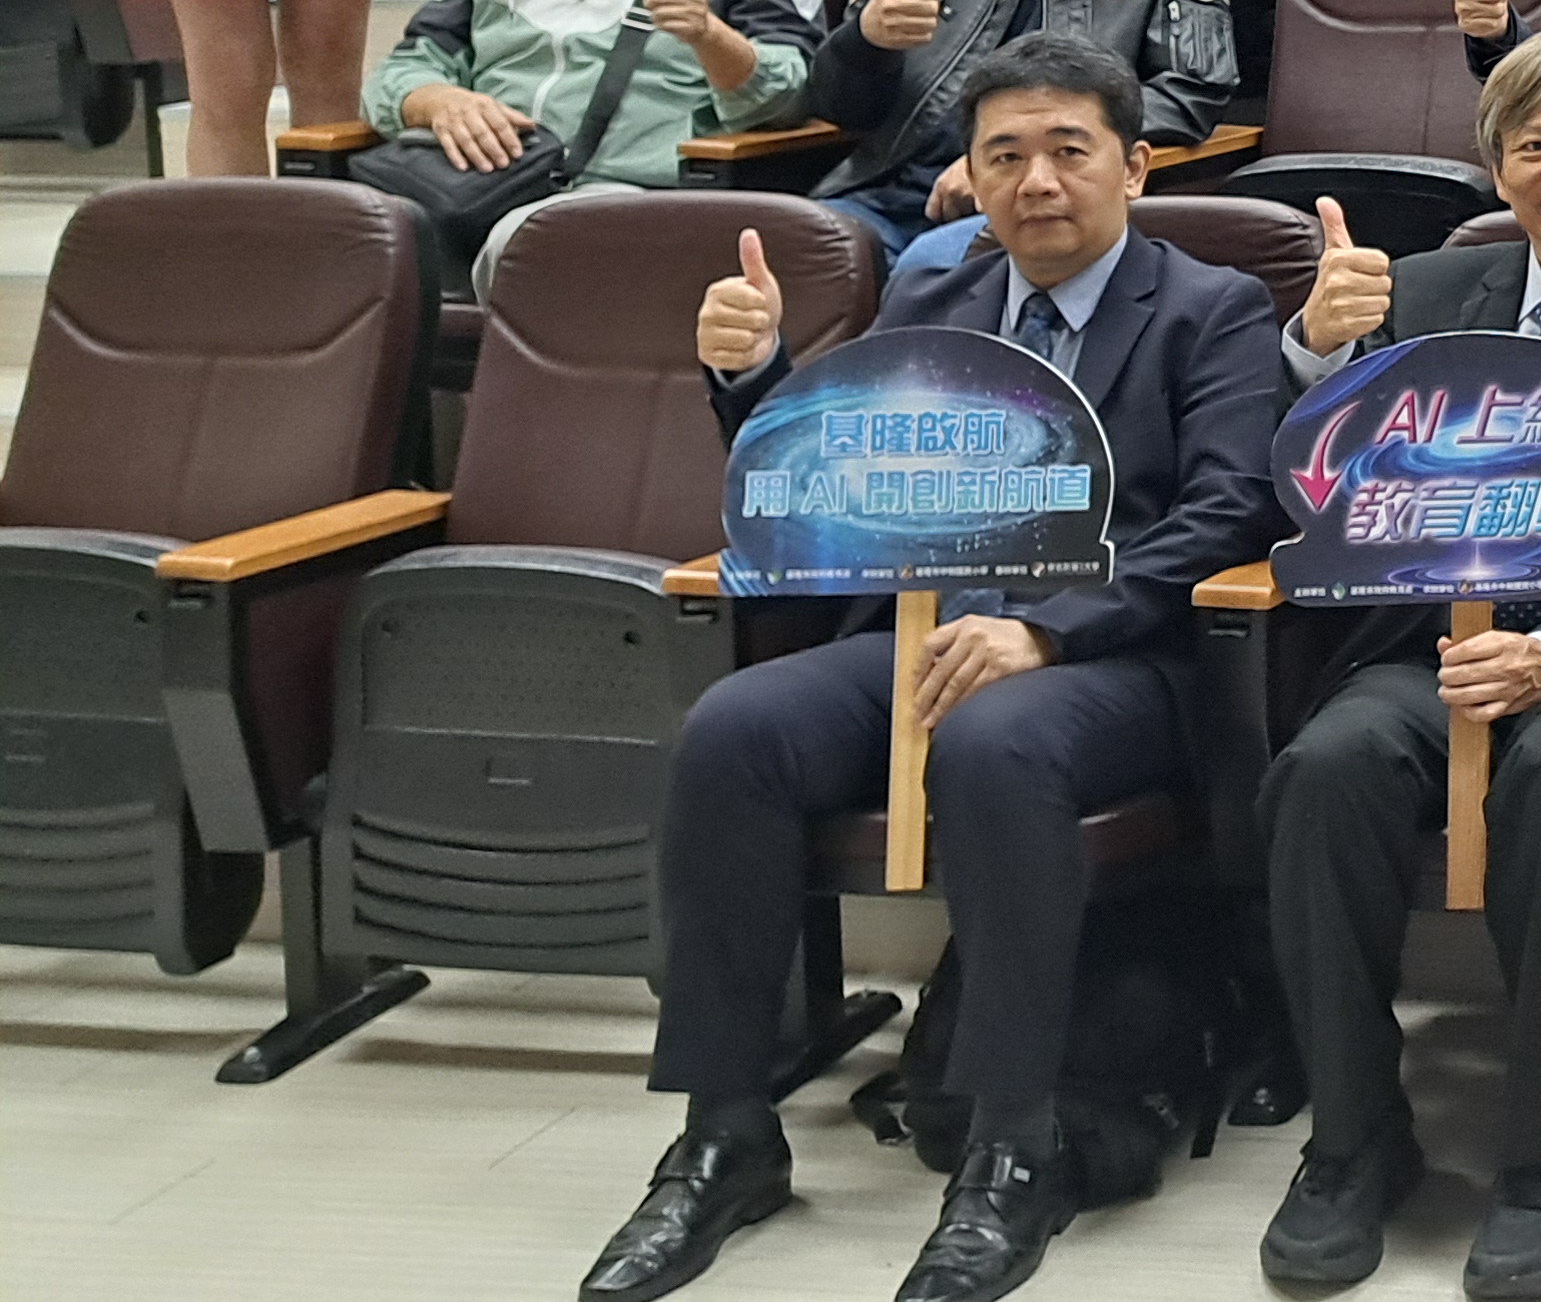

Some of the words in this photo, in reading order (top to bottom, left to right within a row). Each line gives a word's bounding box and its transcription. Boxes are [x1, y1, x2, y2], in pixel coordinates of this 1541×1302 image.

[820, 409, 1005, 459] 基隆啟航
[1376, 389, 1442, 446] AI
[865, 463, 1091, 516] 開創新航道
